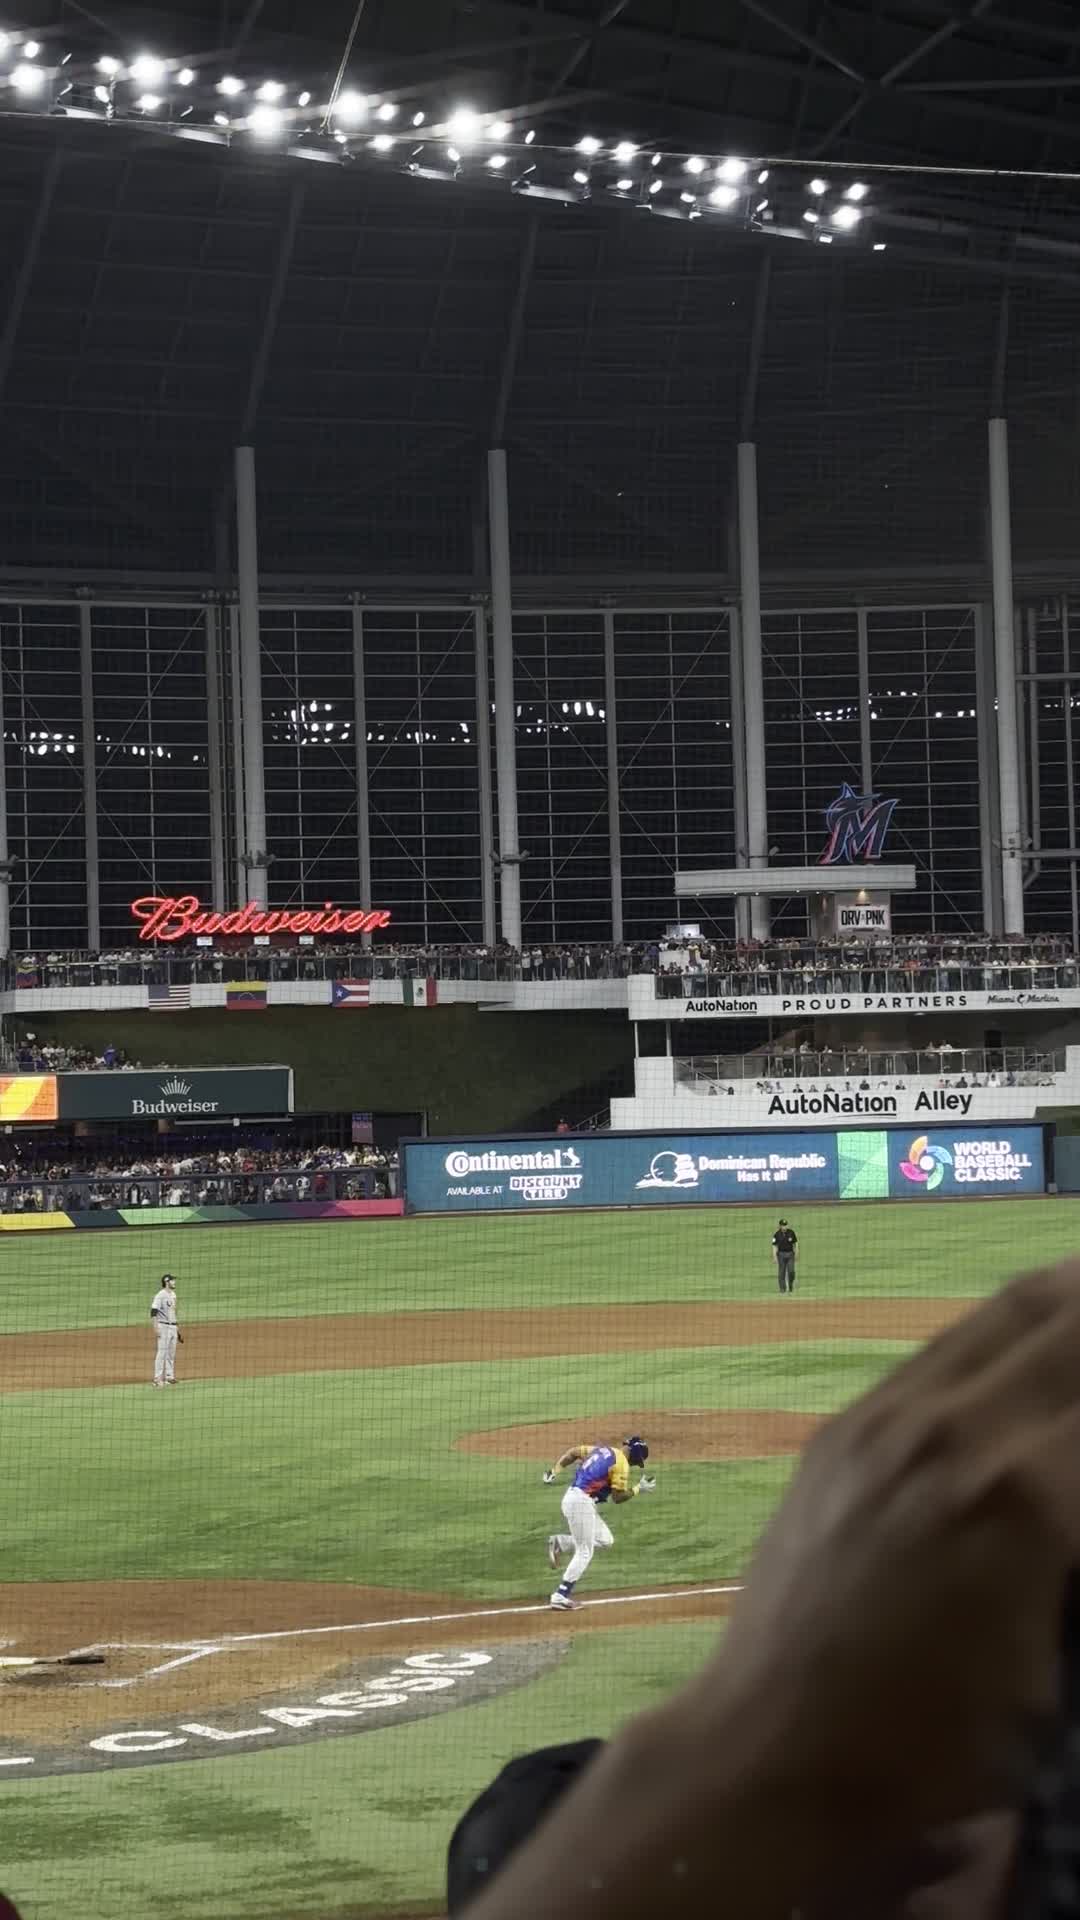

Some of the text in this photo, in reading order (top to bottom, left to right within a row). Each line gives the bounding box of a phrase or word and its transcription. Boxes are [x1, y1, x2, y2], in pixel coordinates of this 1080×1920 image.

[131, 896, 391, 940] Budweiser
[841, 909, 885, 926] DRV PNK
[686, 1000, 757, 1012] AutoNation
[783, 998, 851, 1011] PROUD
[864, 995, 967, 1008] PARTNERS
[132, 1099, 218, 1114] Budweiser
[768, 1090, 973, 1115] AutoNation Alley
[953, 1141, 1011, 1155] WORLD
[445, 1149, 562, 1177] Continental
[699, 1153, 826, 1170] Dominican Republic
[954, 1154, 1032, 1169] BASEBALL
[511, 1175, 581, 1189] DISCOUNT
[737, 1170, 788, 1182] Has it all
[954, 1167, 1021, 1182] CLASSIC
[446, 1185, 503, 1196] AVAILABLE AT
[528, 1189, 563, 1199] TIRE
[89, 1650, 493, 1753] CLASSIC
